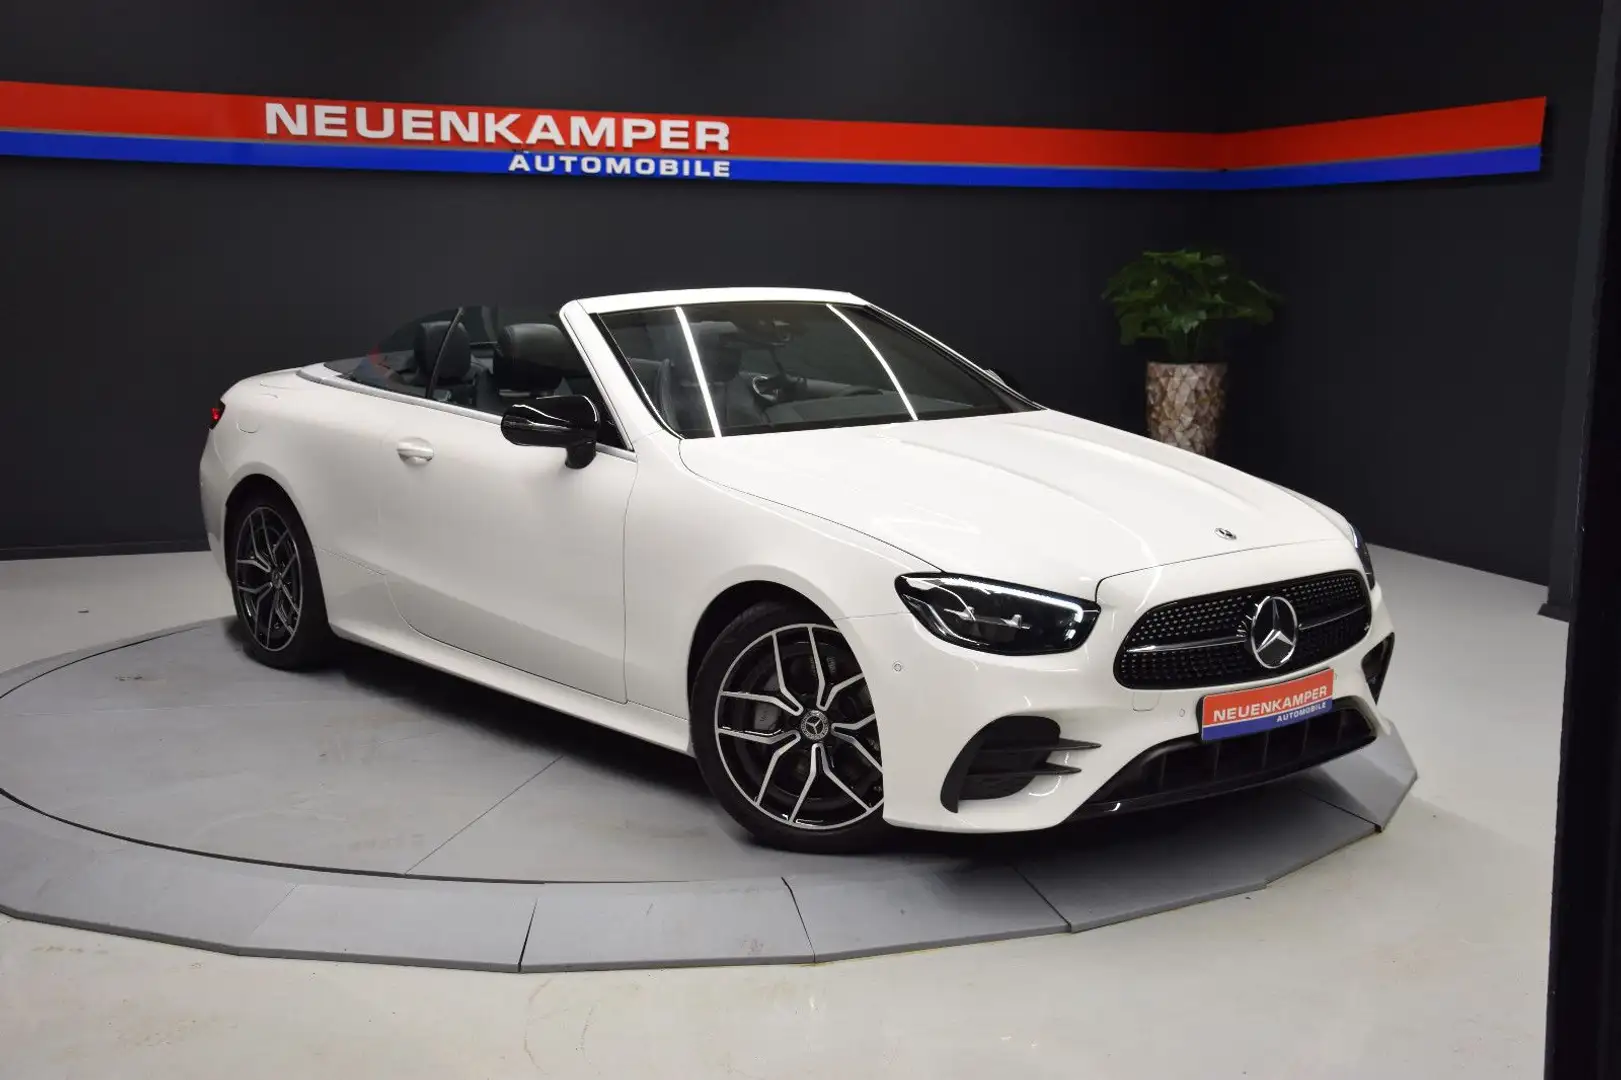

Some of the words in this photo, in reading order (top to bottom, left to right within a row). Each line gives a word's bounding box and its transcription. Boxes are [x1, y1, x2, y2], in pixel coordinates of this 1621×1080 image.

[265, 102, 730, 151] NEUENKAMPER
[508, 154, 730, 177] AUTOMOBILE
[1213, 685, 1328, 722] NEUENKAMPER
[1276, 701, 1327, 722] AUTOMOBILE
